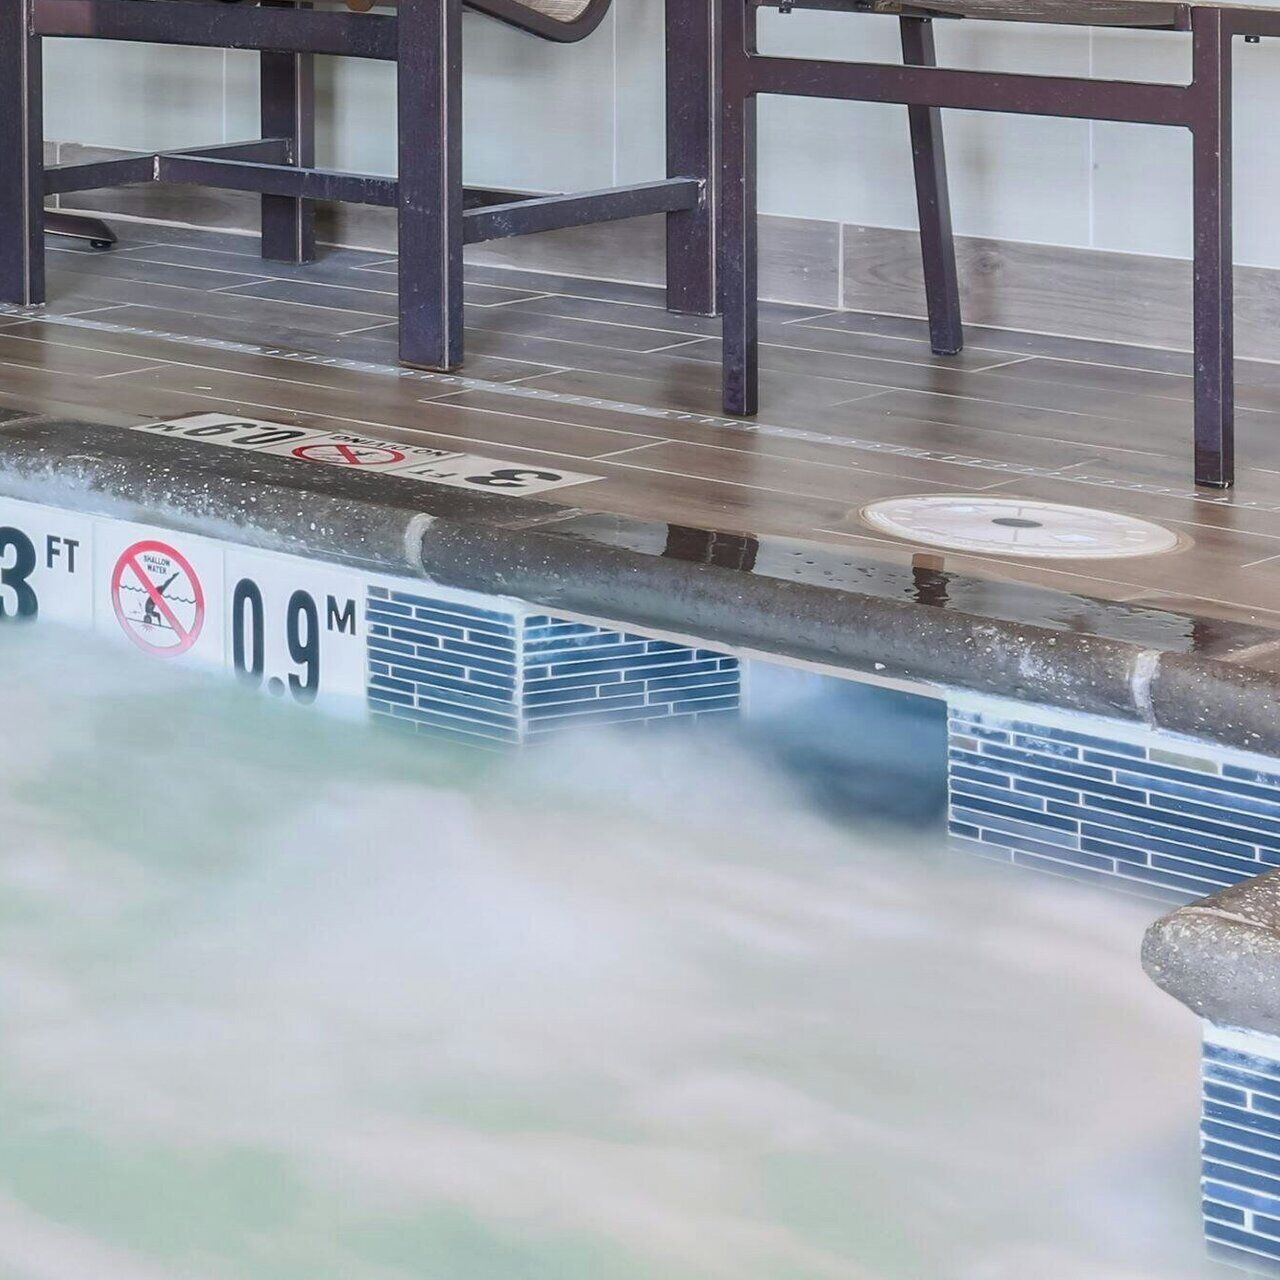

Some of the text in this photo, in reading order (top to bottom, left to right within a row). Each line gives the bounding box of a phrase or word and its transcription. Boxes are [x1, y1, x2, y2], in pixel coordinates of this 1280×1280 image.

[465, 469, 562, 487] 3
[46, 535, 79, 573] FT
[233, 578, 356, 705] 0.9 M
